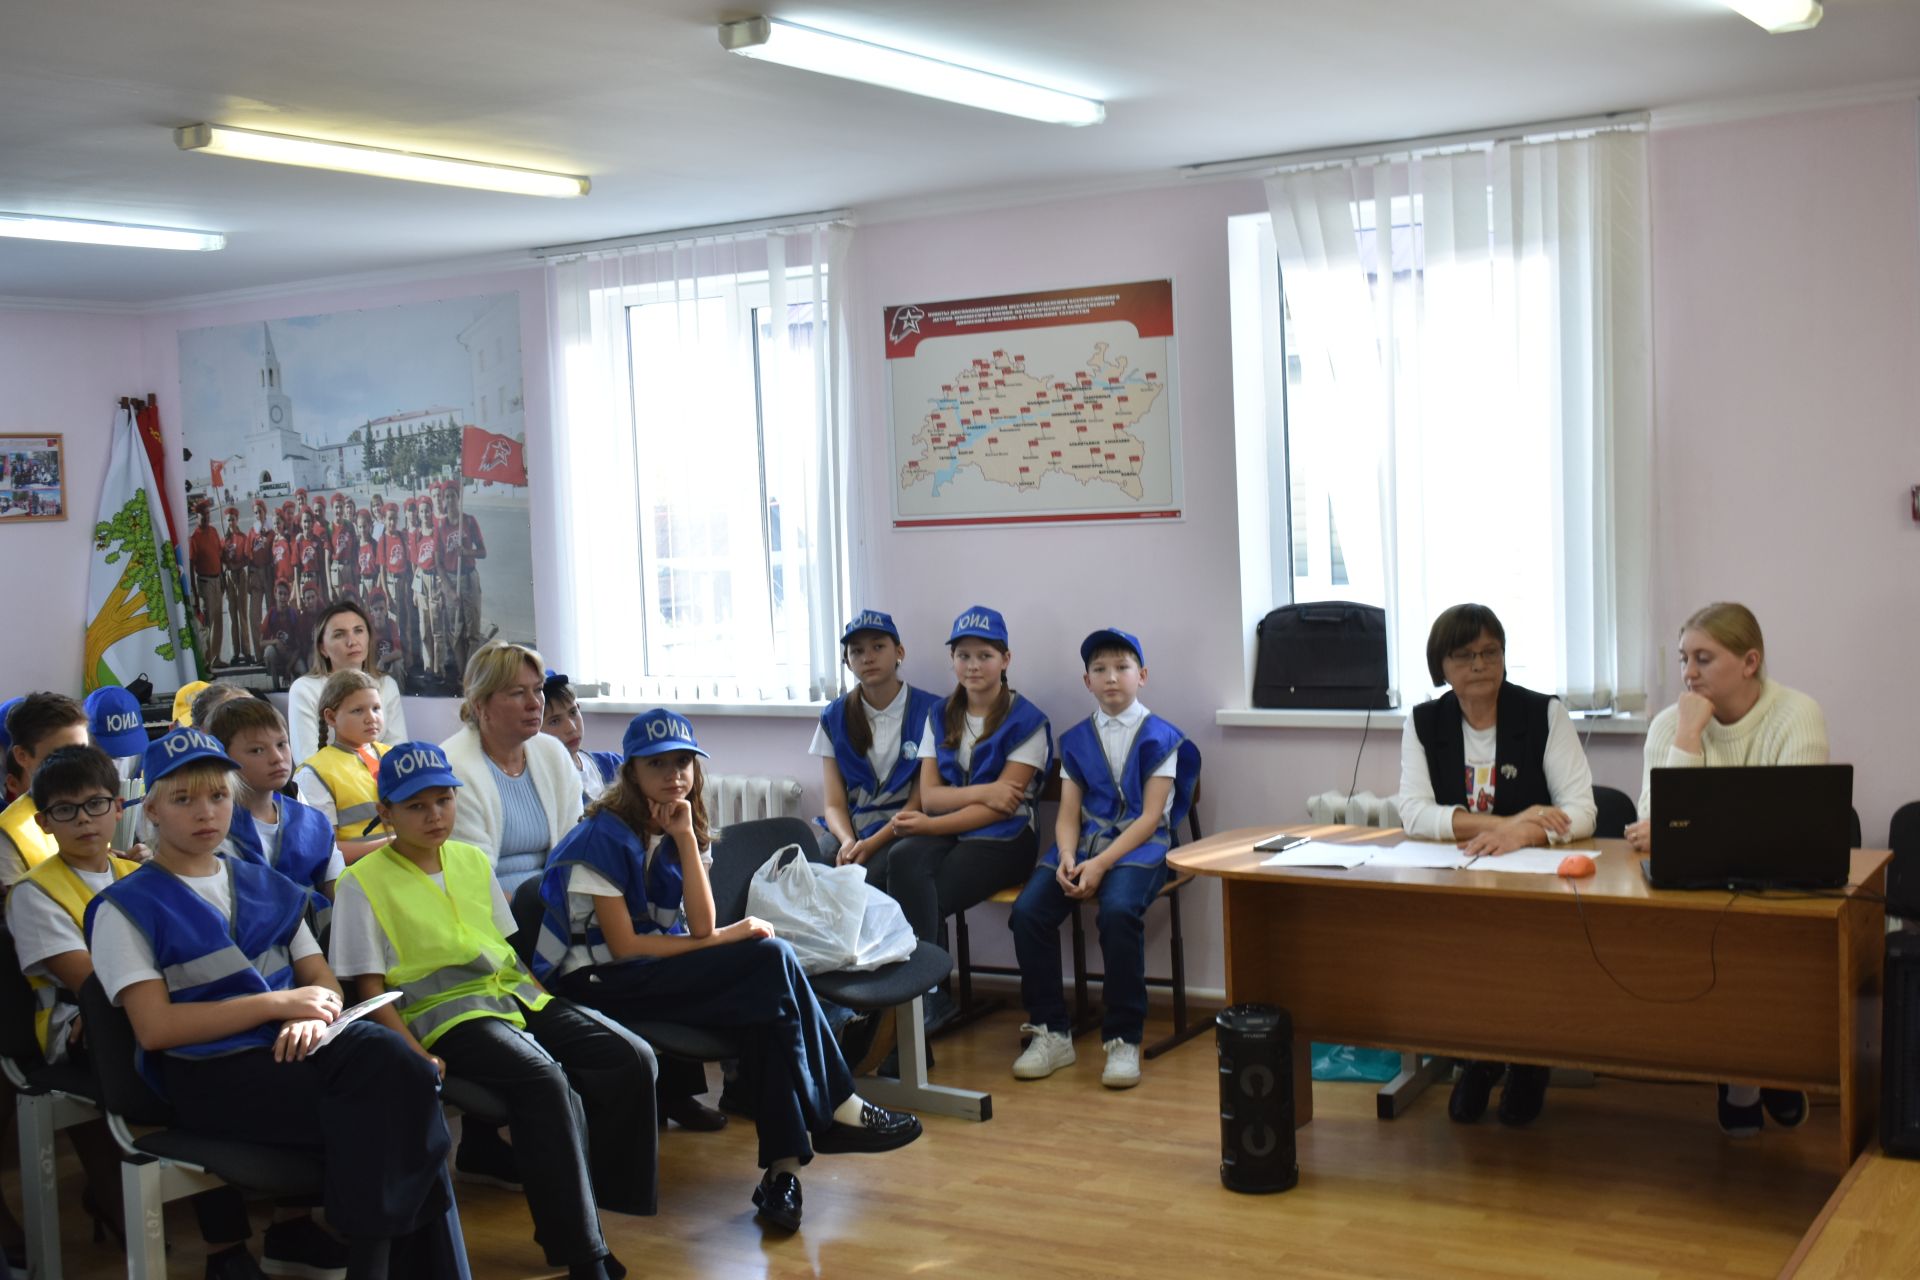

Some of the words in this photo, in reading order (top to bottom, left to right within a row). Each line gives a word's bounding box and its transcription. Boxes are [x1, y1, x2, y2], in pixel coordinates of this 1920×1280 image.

[956, 612, 990, 632] ЮИД
[106, 711, 139, 733] ЮИД
[645, 718, 692, 743] ЮИД
[163, 730, 220, 758] ЮИД
[393, 748, 445, 778] ЮИД
